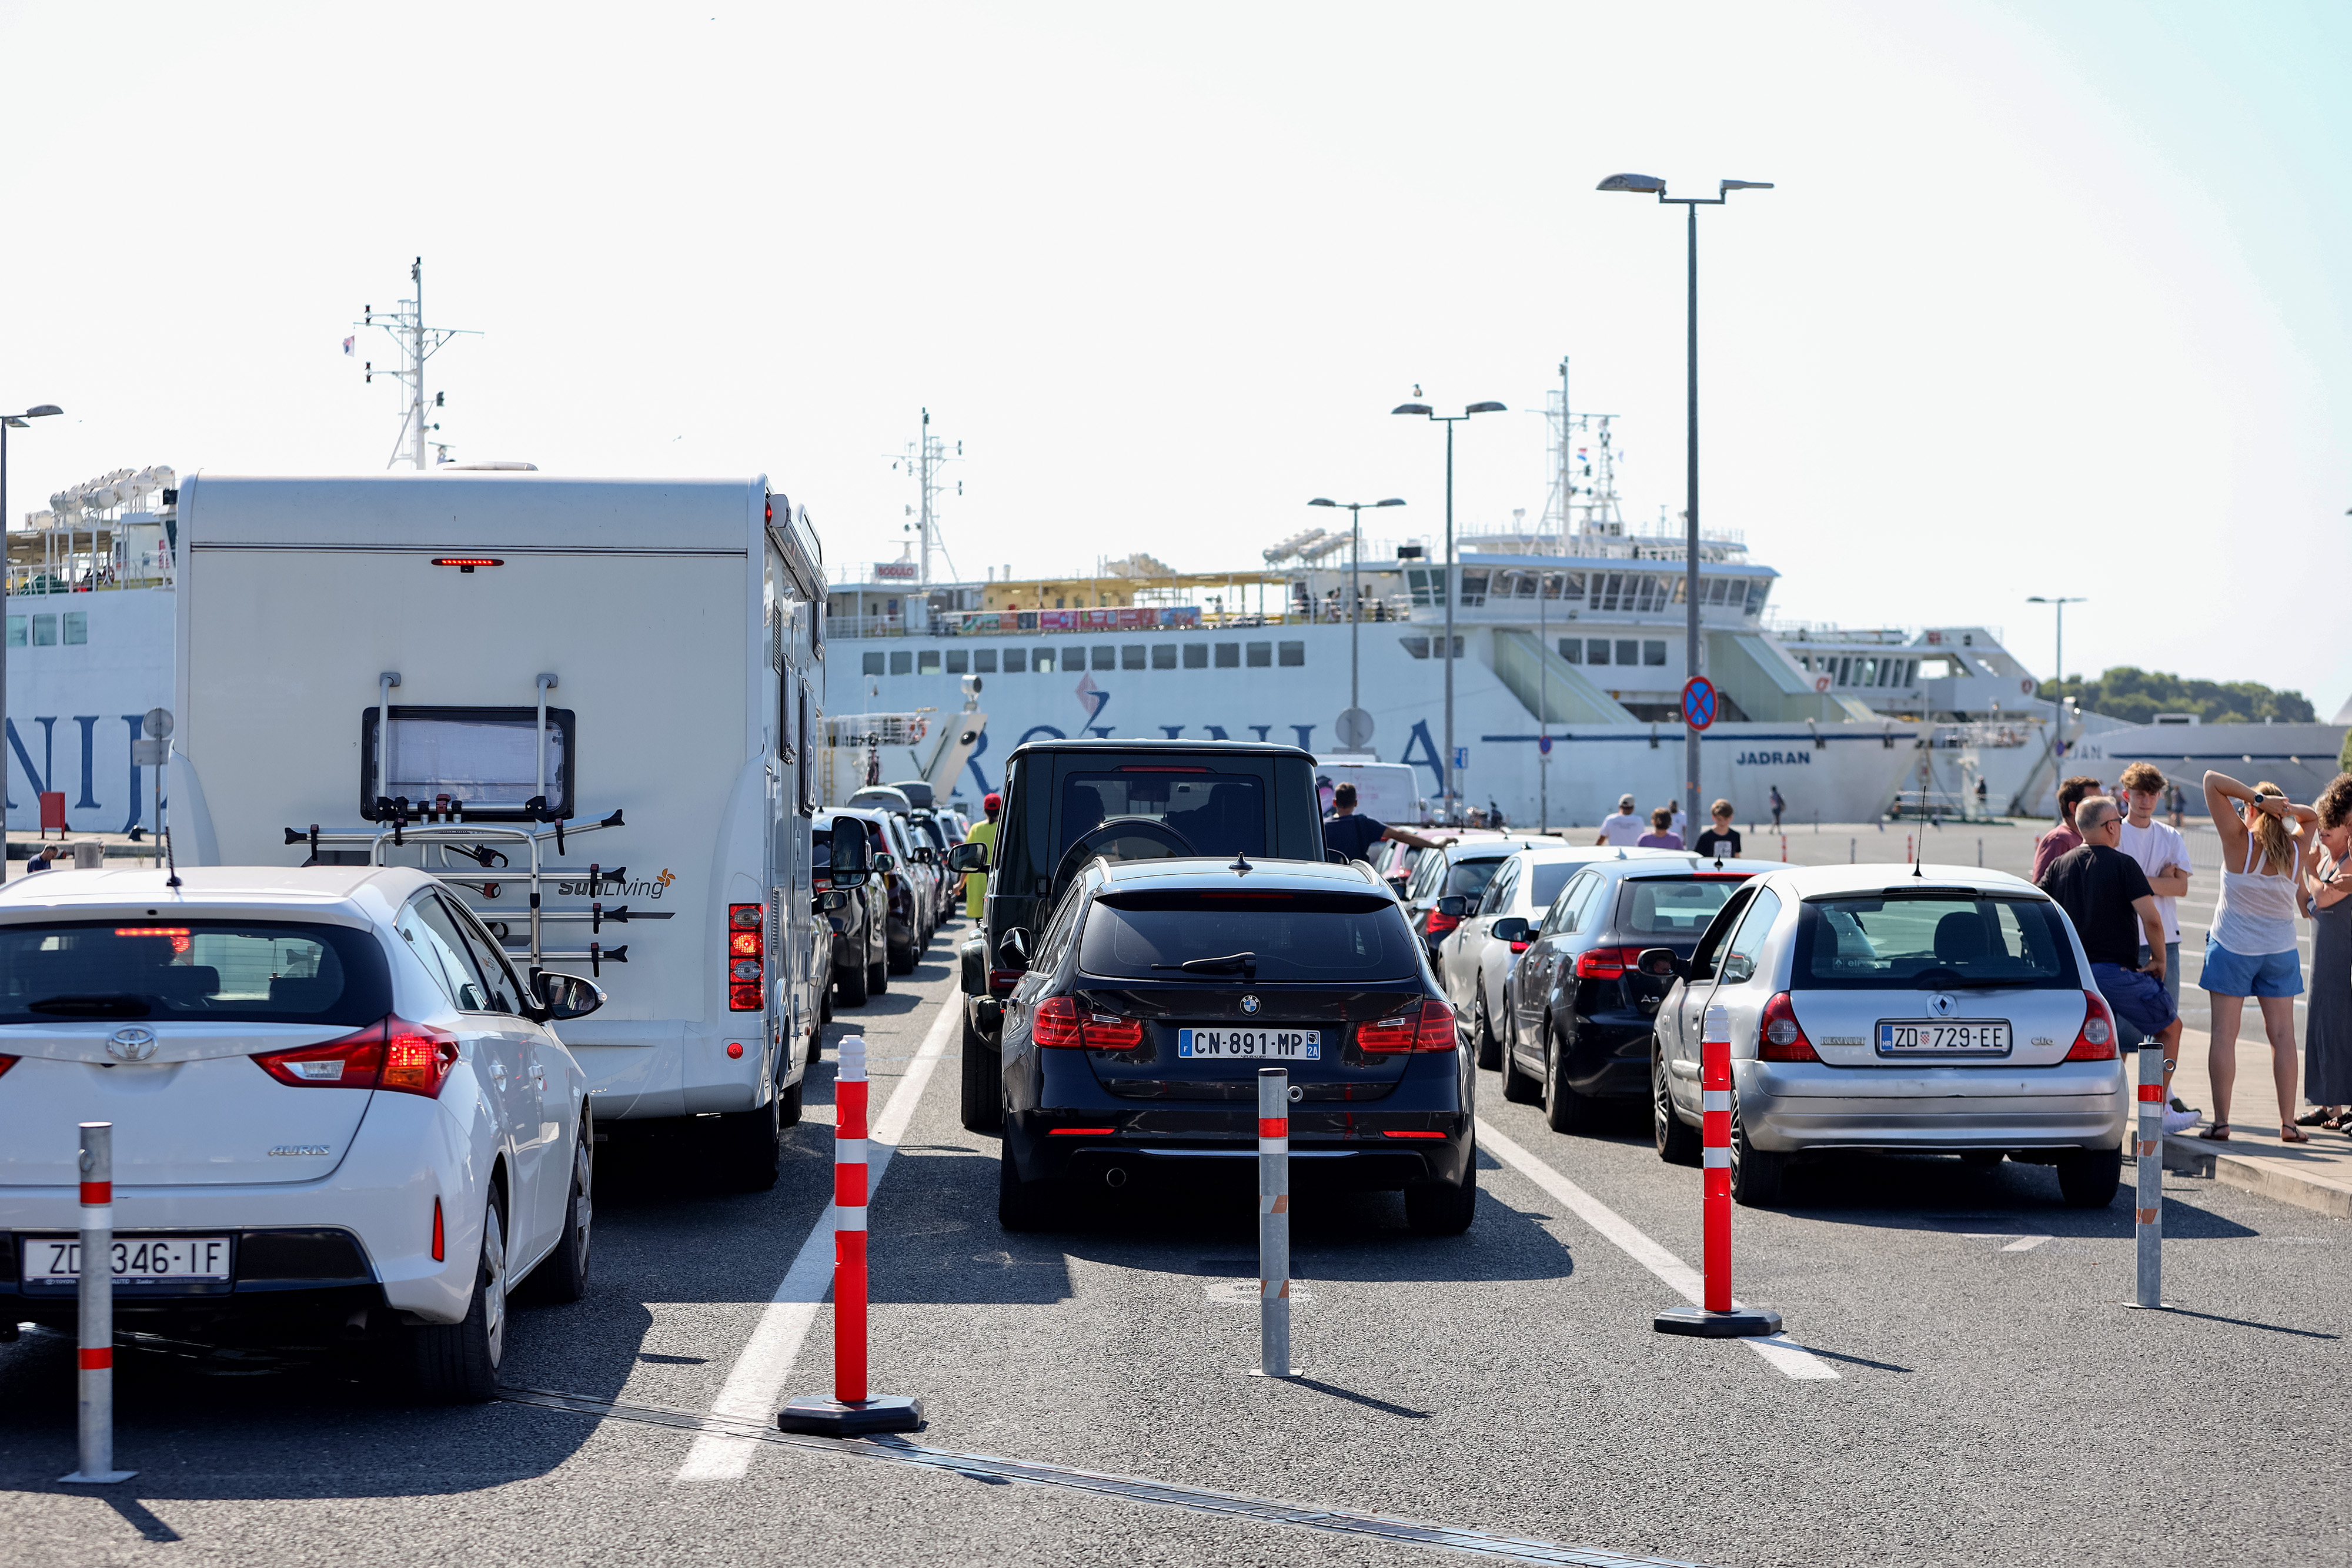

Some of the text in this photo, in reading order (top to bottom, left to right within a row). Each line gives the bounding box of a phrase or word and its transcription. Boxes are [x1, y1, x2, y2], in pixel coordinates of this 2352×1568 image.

[1736, 751, 1810, 765] JADRAN
[1641, 994, 1660, 1002] A3
[1195, 1032, 1302, 1055] CN-891-MP
[1820, 1036, 1866, 1045] RENAULT
[1895, 1028, 2003, 1047] ZD 729-EE
[1307, 1046, 1318, 1057] 2A
[269, 1145, 330, 1156] AURIS
[112, 1242, 221, 1274] 346-IF
